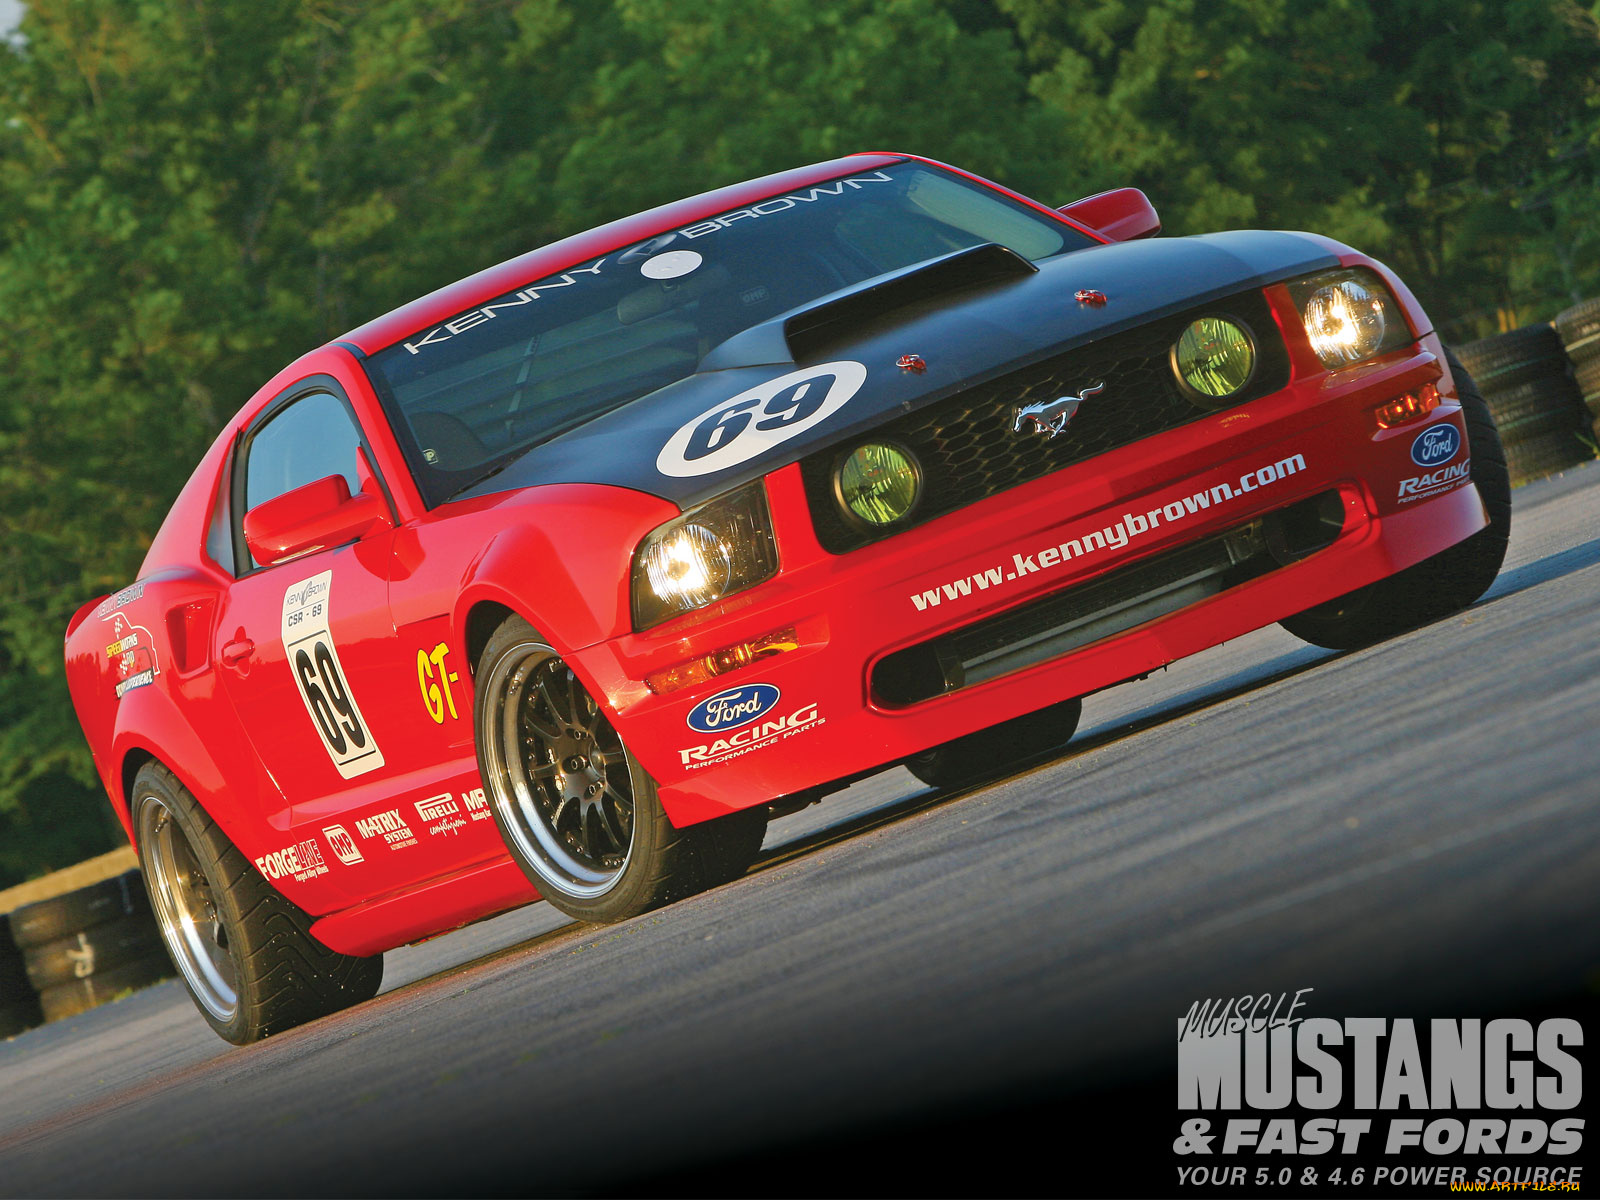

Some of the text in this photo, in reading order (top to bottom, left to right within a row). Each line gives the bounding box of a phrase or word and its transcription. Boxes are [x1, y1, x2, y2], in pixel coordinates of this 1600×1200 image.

[403, 171, 893, 355] KENNY BROWN
[683, 374, 837, 461] 69
[1422, 430, 1453, 461] Ford
[1398, 458, 1471, 497] RACING
[910, 453, 1307, 612] www.kennybrown.com
[288, 611, 303, 627] CSR
[312, 604, 322, 618] 69
[296, 641, 366, 755] 69
[705, 692, 762, 727] Ford
[678, 702, 818, 765] RACING
[685, 717, 826, 770] PERFORMANCE PARTS
[354, 808, 408, 840] MATRIX
[413, 792, 460, 822] PIRELLI
[329, 832, 356, 858] OMP
[383, 827, 414, 844] SYSTEM
[254, 838, 325, 882] FORGELINE
